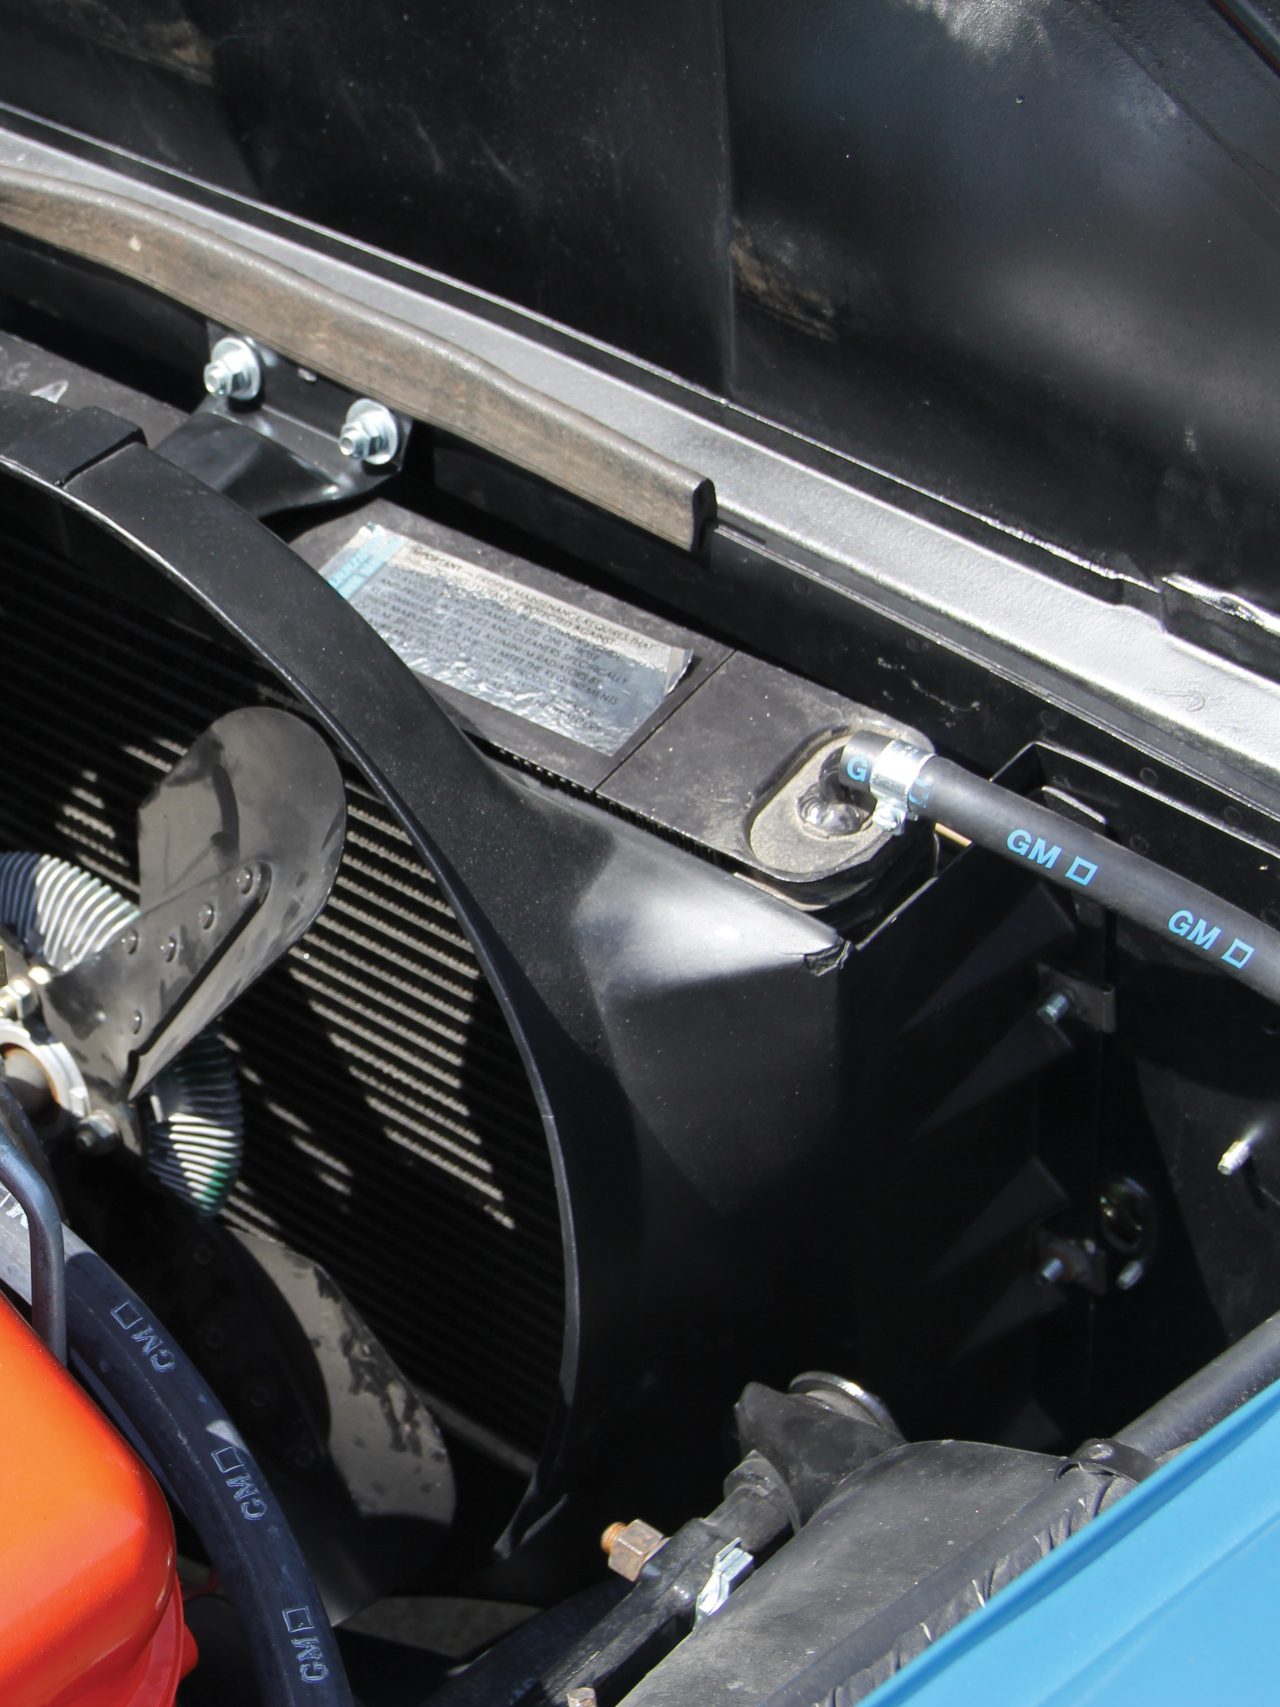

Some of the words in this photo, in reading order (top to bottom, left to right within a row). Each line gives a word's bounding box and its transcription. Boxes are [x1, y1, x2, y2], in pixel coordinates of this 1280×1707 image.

[1006, 828, 1062, 870] GM
[1167, 909, 1222, 950] GM
[131, 1325, 177, 1373] GM
[226, 1473, 268, 1521] GM
[291, 1636, 329, 1684] GM
